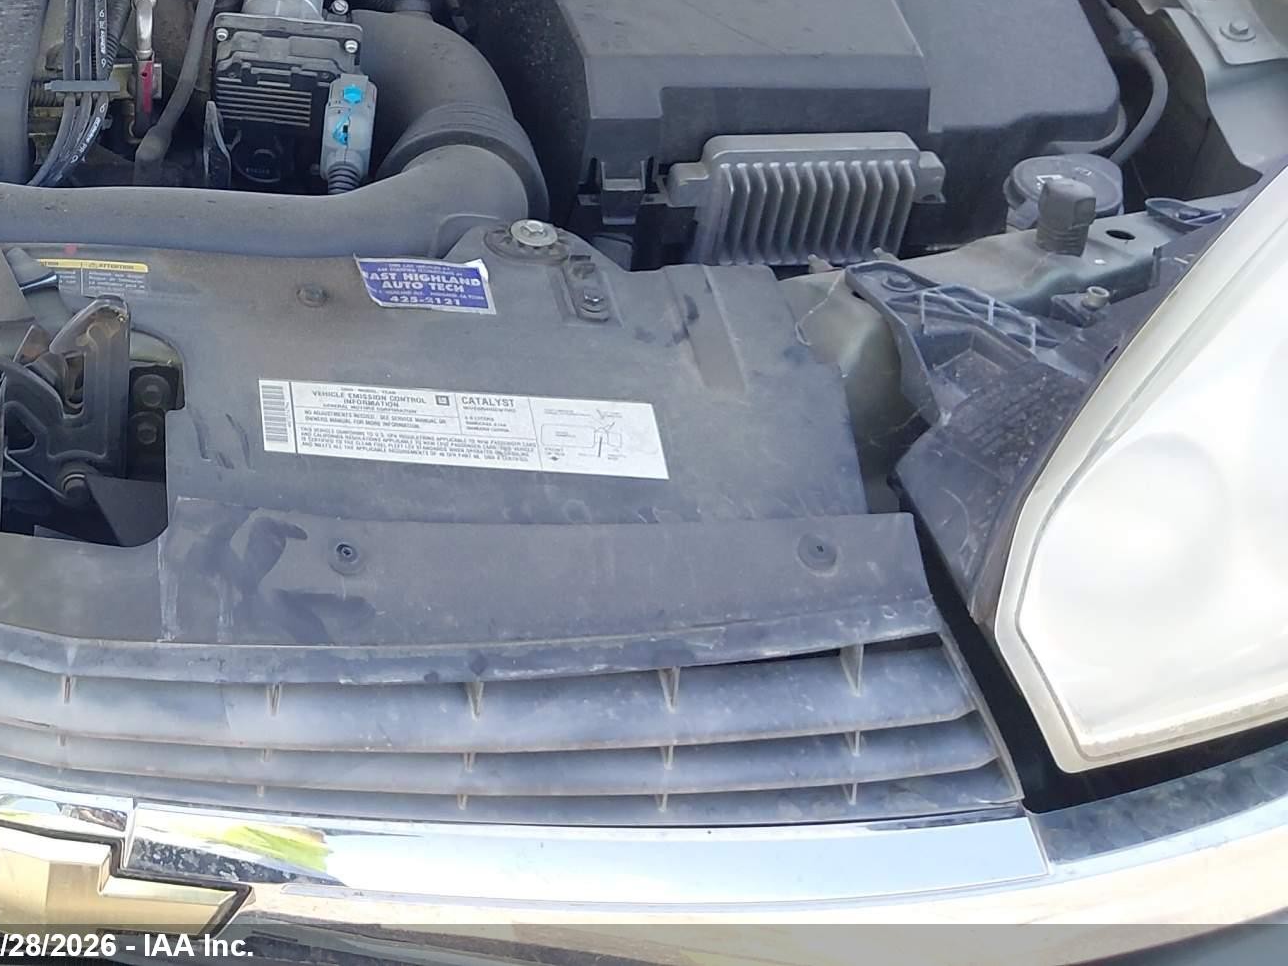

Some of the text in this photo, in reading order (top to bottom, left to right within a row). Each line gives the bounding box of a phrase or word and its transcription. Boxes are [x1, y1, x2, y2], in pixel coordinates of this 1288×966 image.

[403, 273, 481, 286] HIGHLAND
[382, 281, 465, 292] AUTO TECH
[312, 390, 344, 398] VEHICLE
[389, 395, 426, 404] CONTROL
[462, 396, 514, 407] CATALYST
[343, 399, 399, 407] INFORMATION
